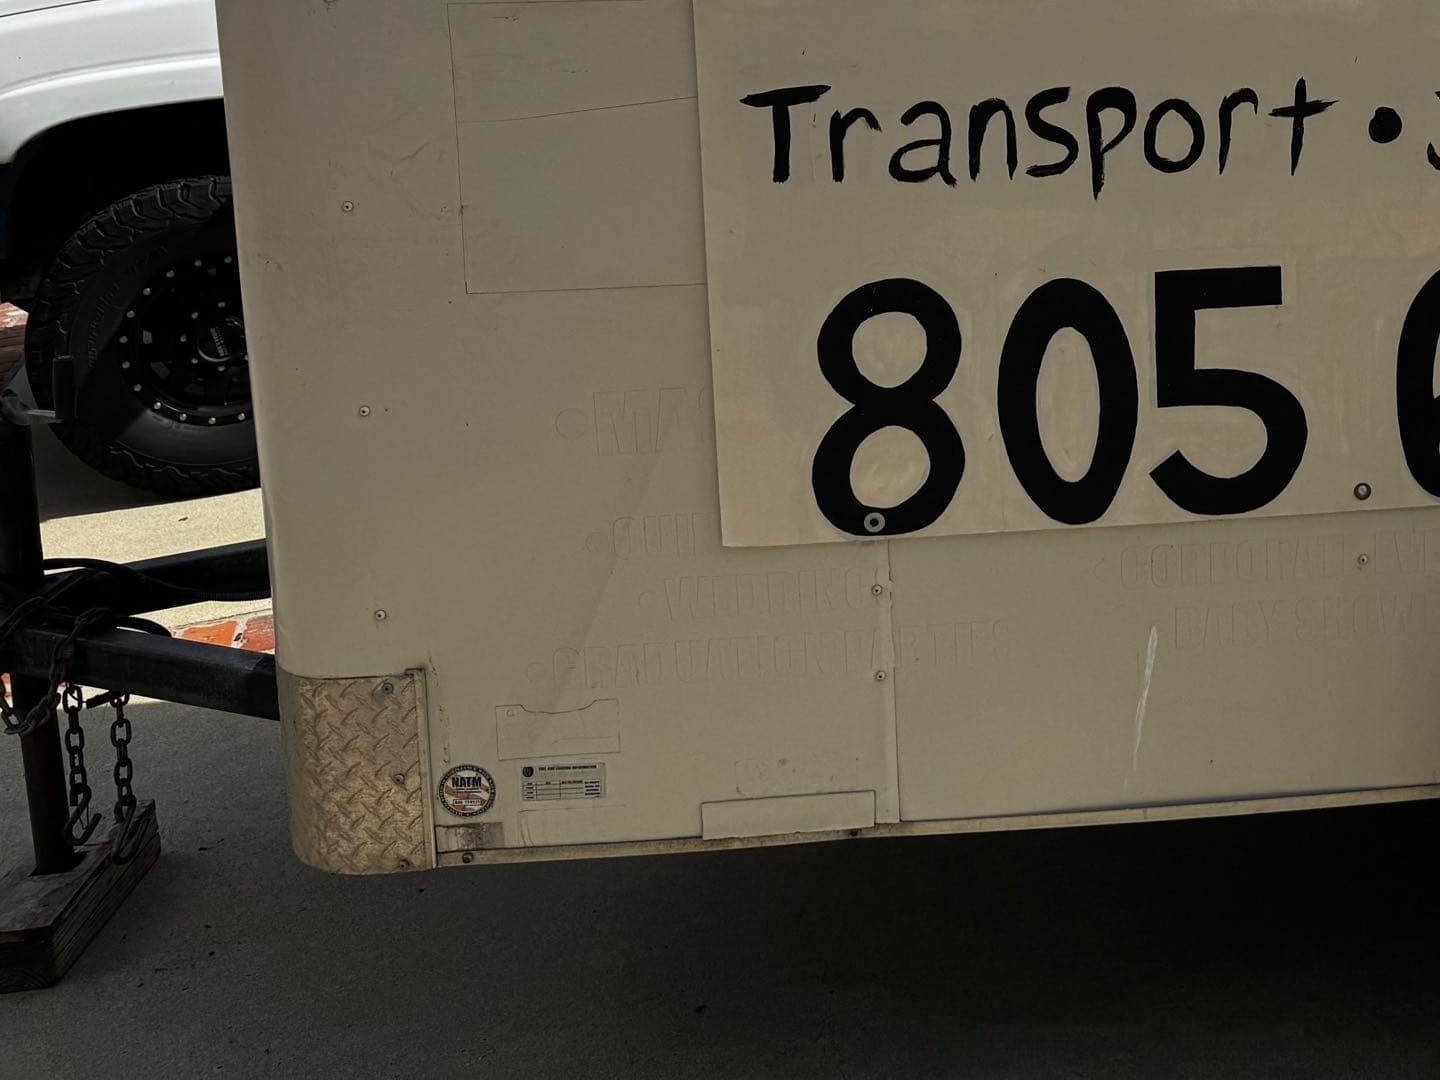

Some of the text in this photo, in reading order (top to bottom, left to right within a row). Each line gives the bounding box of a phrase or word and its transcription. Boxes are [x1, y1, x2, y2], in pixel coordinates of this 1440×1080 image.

[739, 76, 1339, 201] Transport
[811, 265, 1309, 537] 805
[451, 776, 482, 788] NATM
